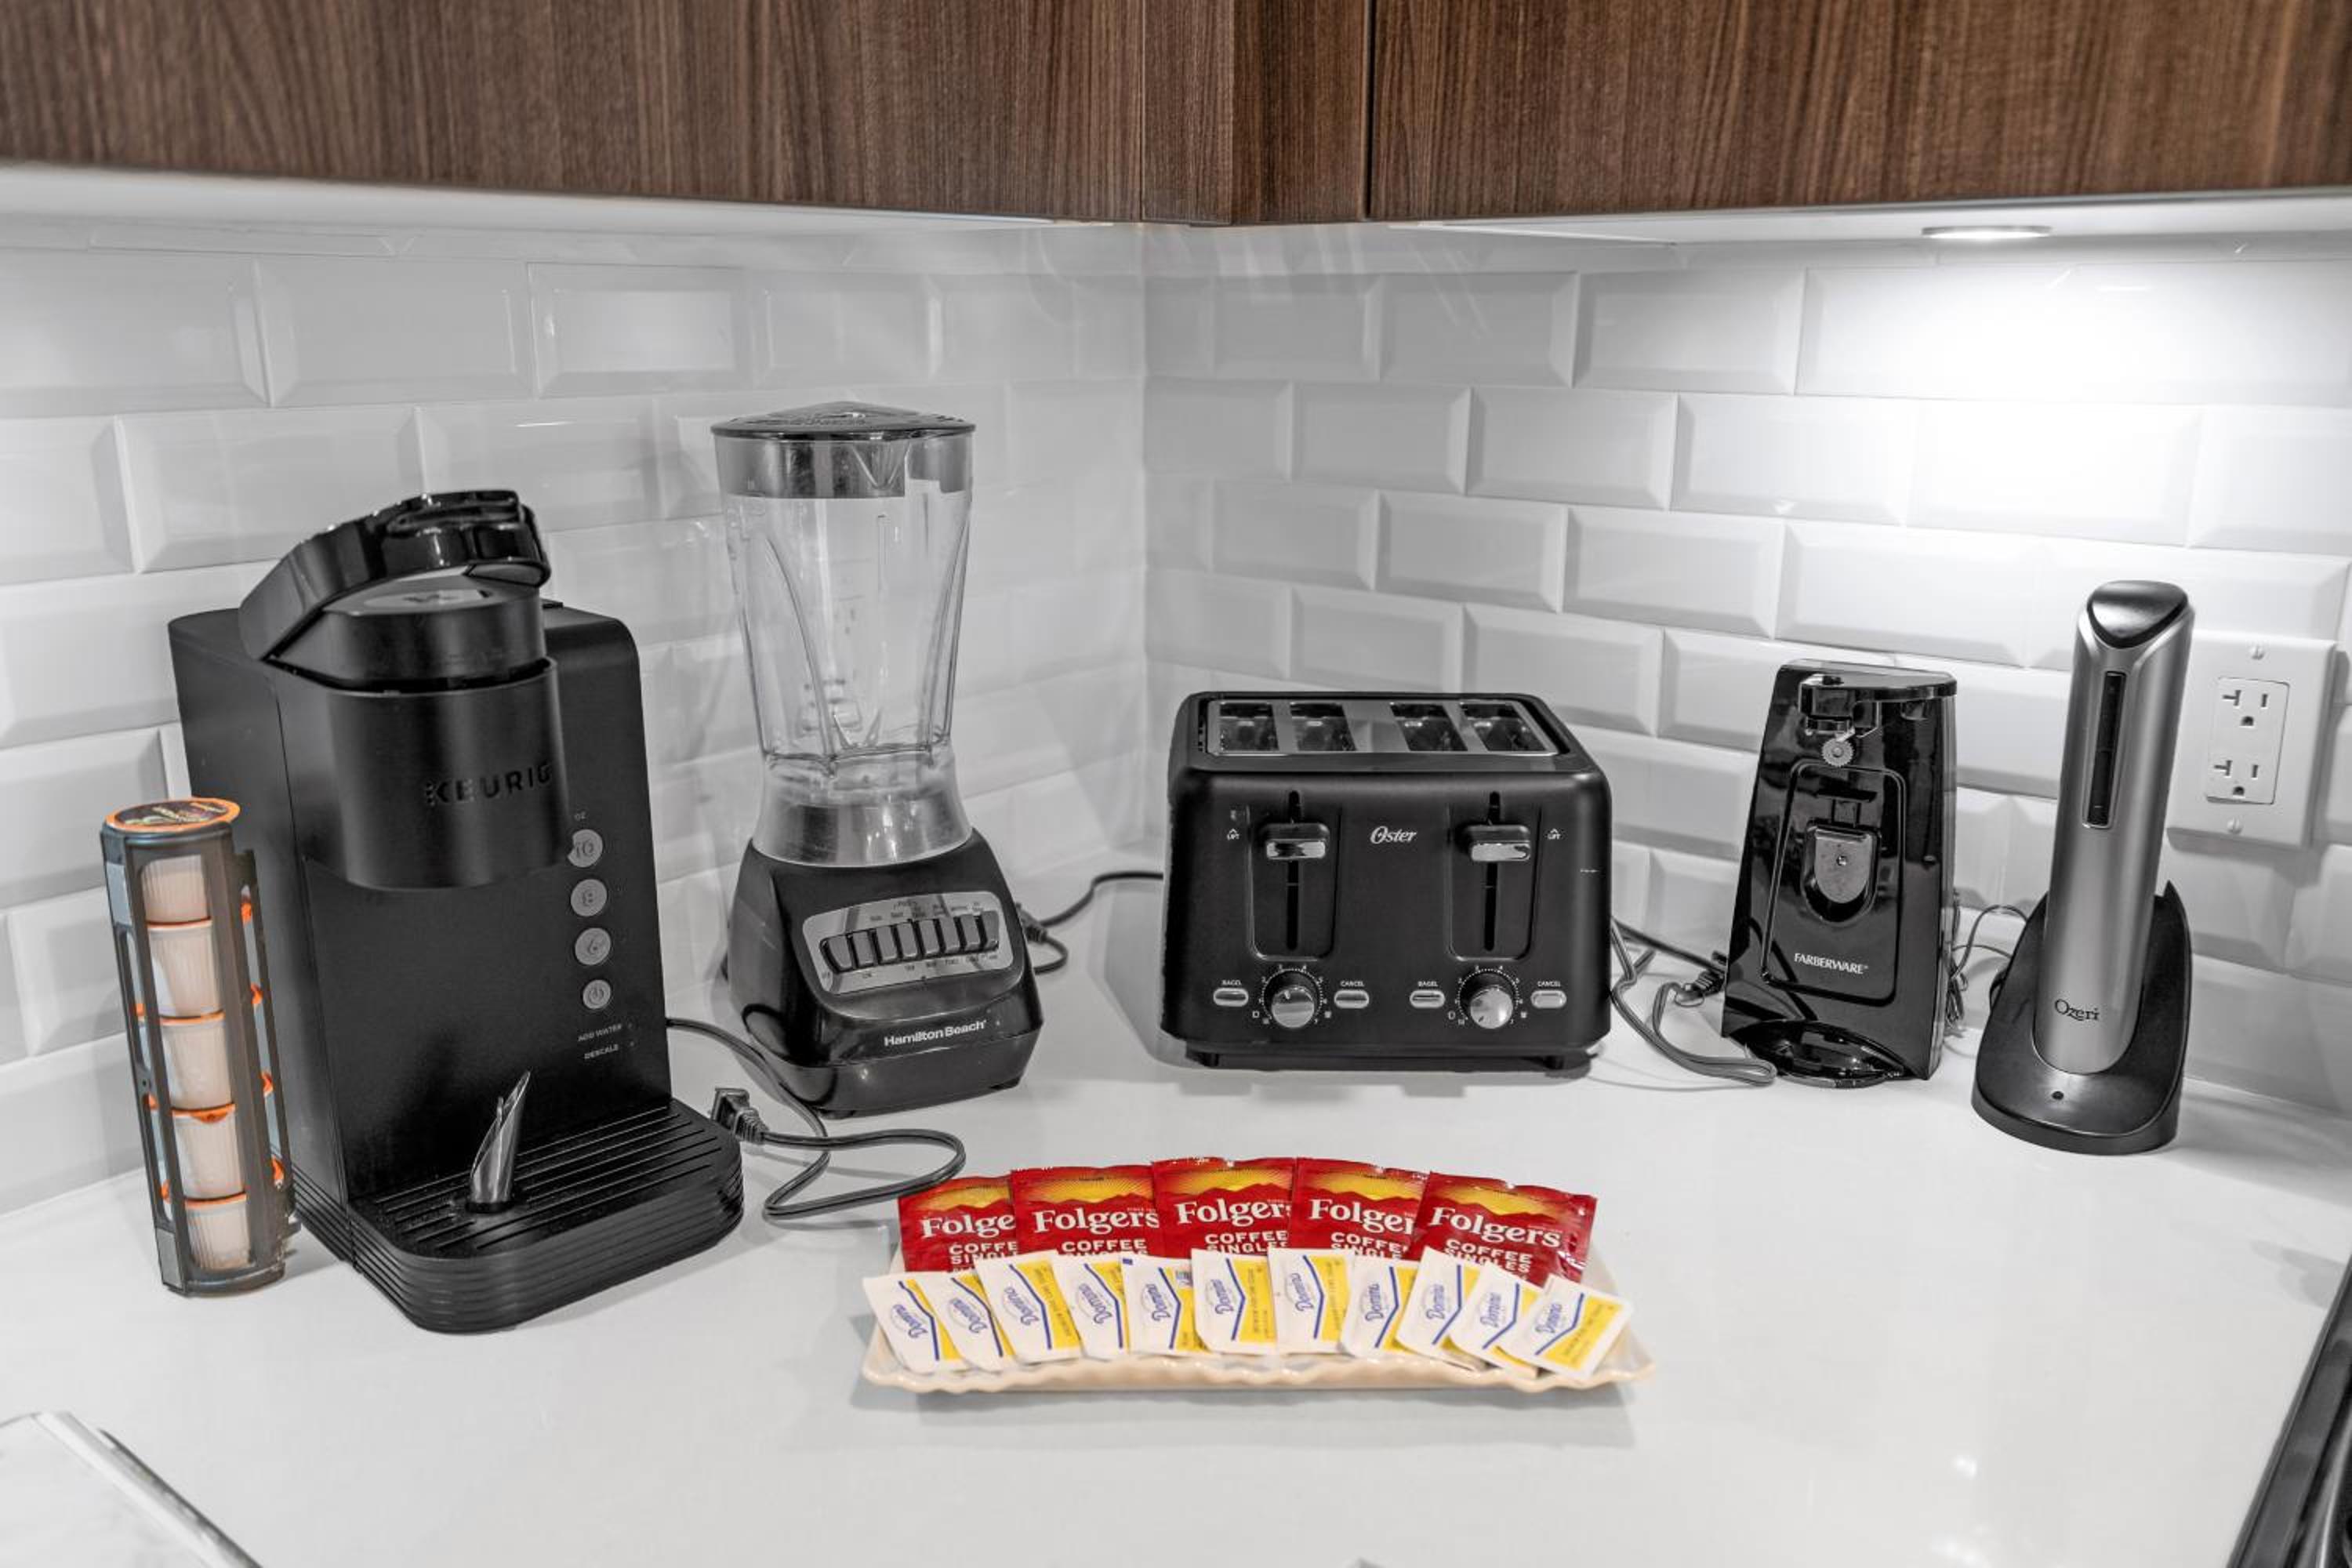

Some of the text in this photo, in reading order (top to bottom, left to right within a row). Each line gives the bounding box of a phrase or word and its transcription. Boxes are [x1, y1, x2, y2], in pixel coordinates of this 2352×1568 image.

[1370, 826, 1417, 844] Oster
[1794, 953, 1864, 975] FARBERWARE
[2055, 999, 2100, 1022] Ozeri
[884, 1020, 985, 1047] Hamilton Beach
[920, 1214, 1016, 1239] Folge
[1032, 1207, 1160, 1236] Folgers
[1428, 1207, 1561, 1248] Folgers
[949, 1241, 1017, 1254] COFFE
[1062, 1239, 1147, 1252] COFFEE
[1205, 1230, 1288, 1244] COFFEE
[1446, 1239, 1533, 1264] COFFEE
[1004, 1286, 1040, 1325] Domino
